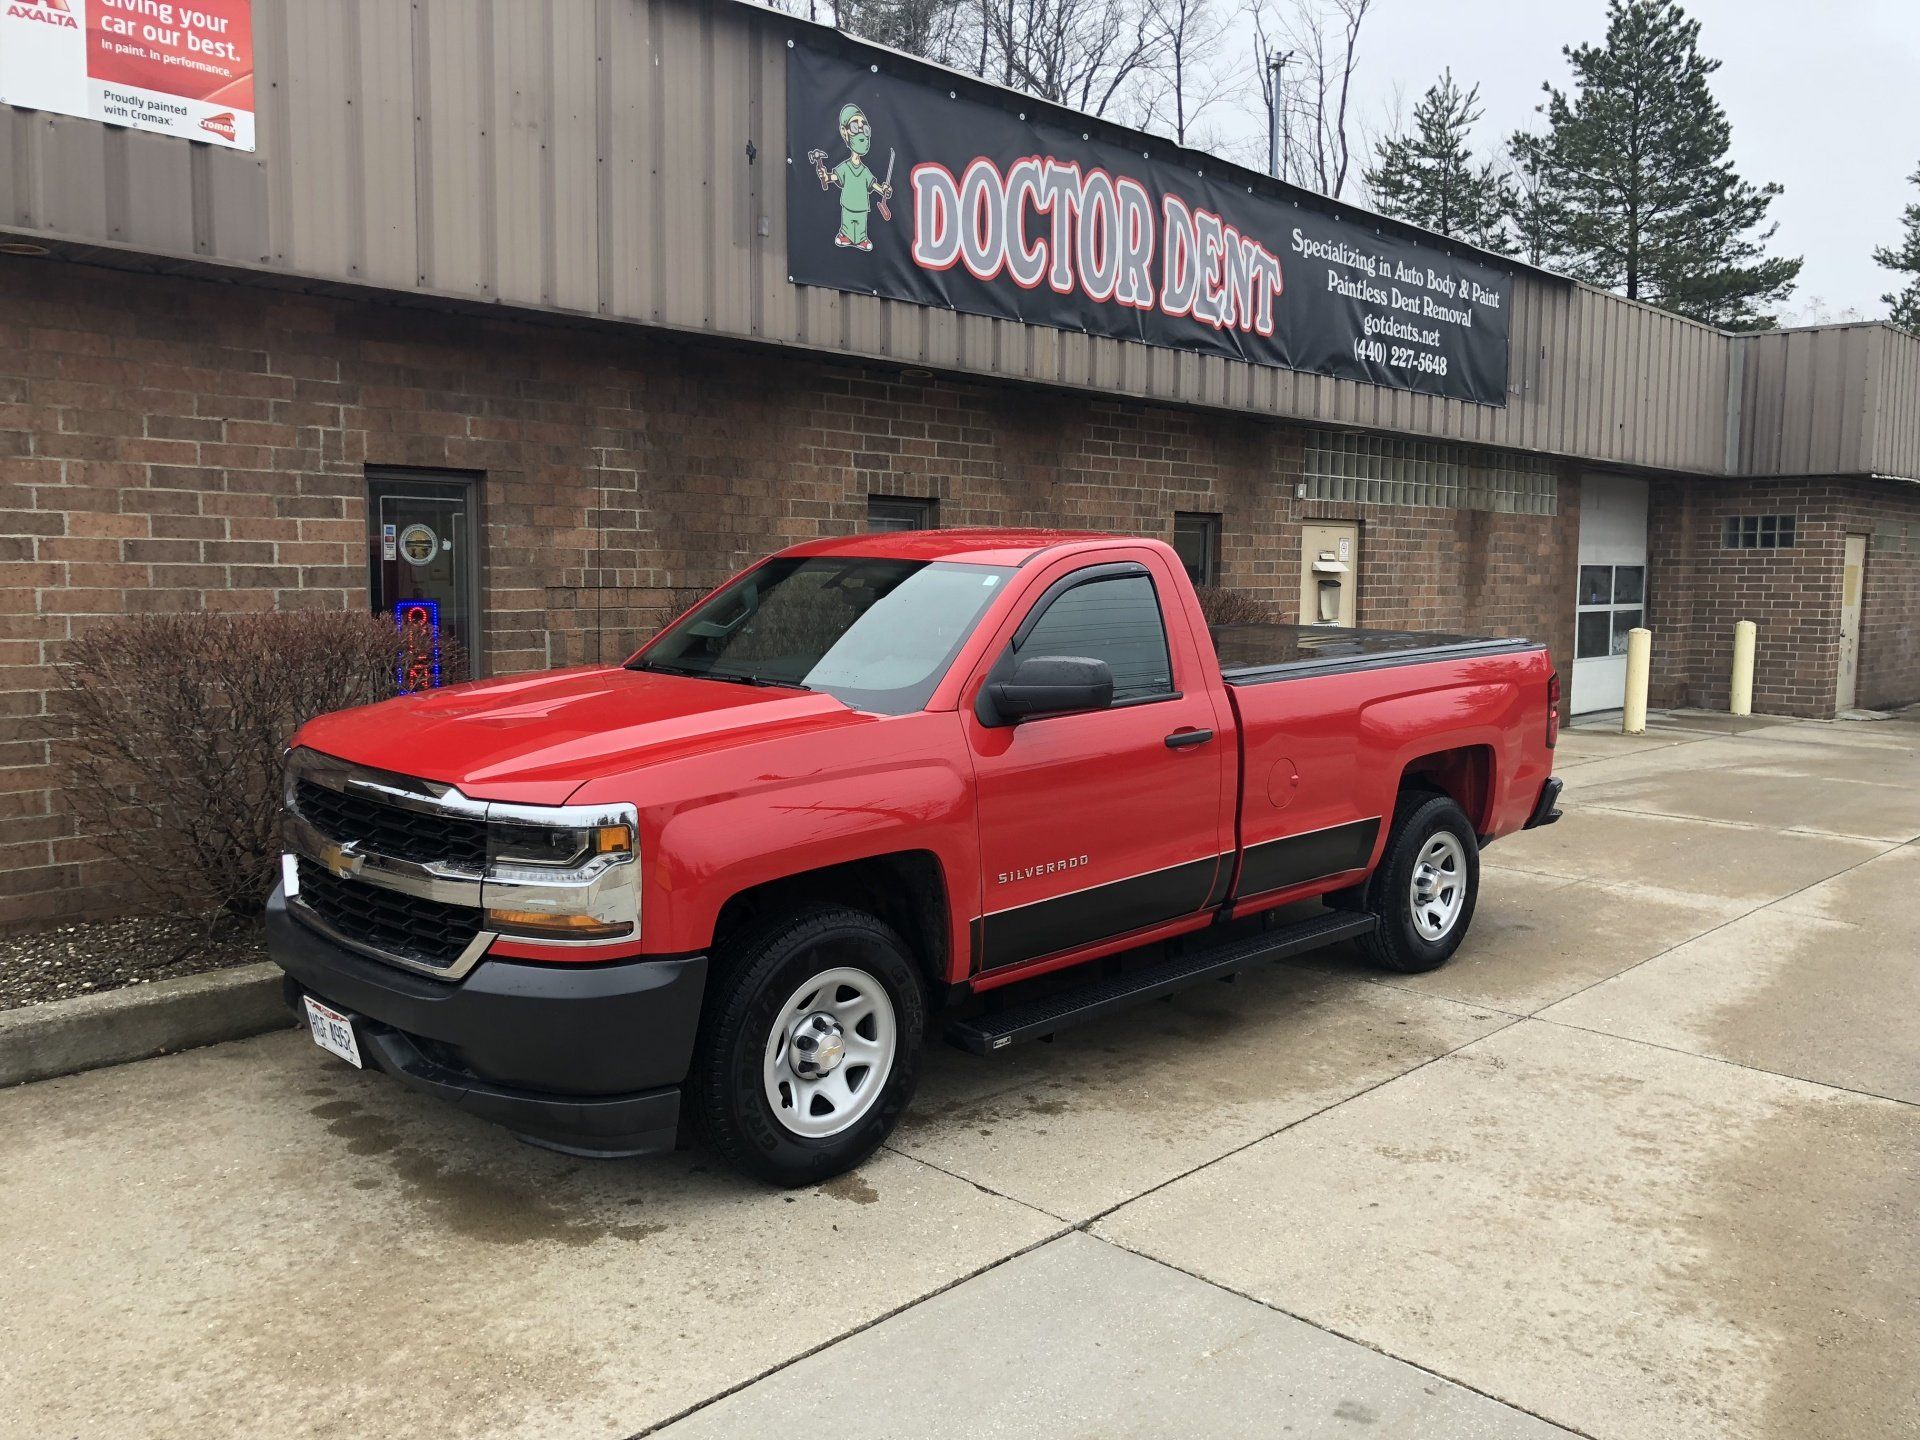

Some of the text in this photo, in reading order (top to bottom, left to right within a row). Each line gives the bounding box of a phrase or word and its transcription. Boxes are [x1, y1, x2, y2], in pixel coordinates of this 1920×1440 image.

[6, 5, 78, 30] AXALTA
[178, 7, 229, 34] your
[100, 15, 241, 62] car our best.
[101, 38, 233, 77] In paint. In performance.
[103, 89, 188, 116] Proudly painted
[103, 104, 129, 119] with
[911, 156, 1284, 337] DOCTOR DENT
[1291, 228, 1500, 309] Specializing in Auto Body & Paint
[1327, 270, 1472, 328] Paintless Dent Removal
[1363, 313, 1440, 348] gotdents.net
[1353, 337, 1448, 377] (440) 227-5648
[998, 854, 1089, 884] SILVERADO
